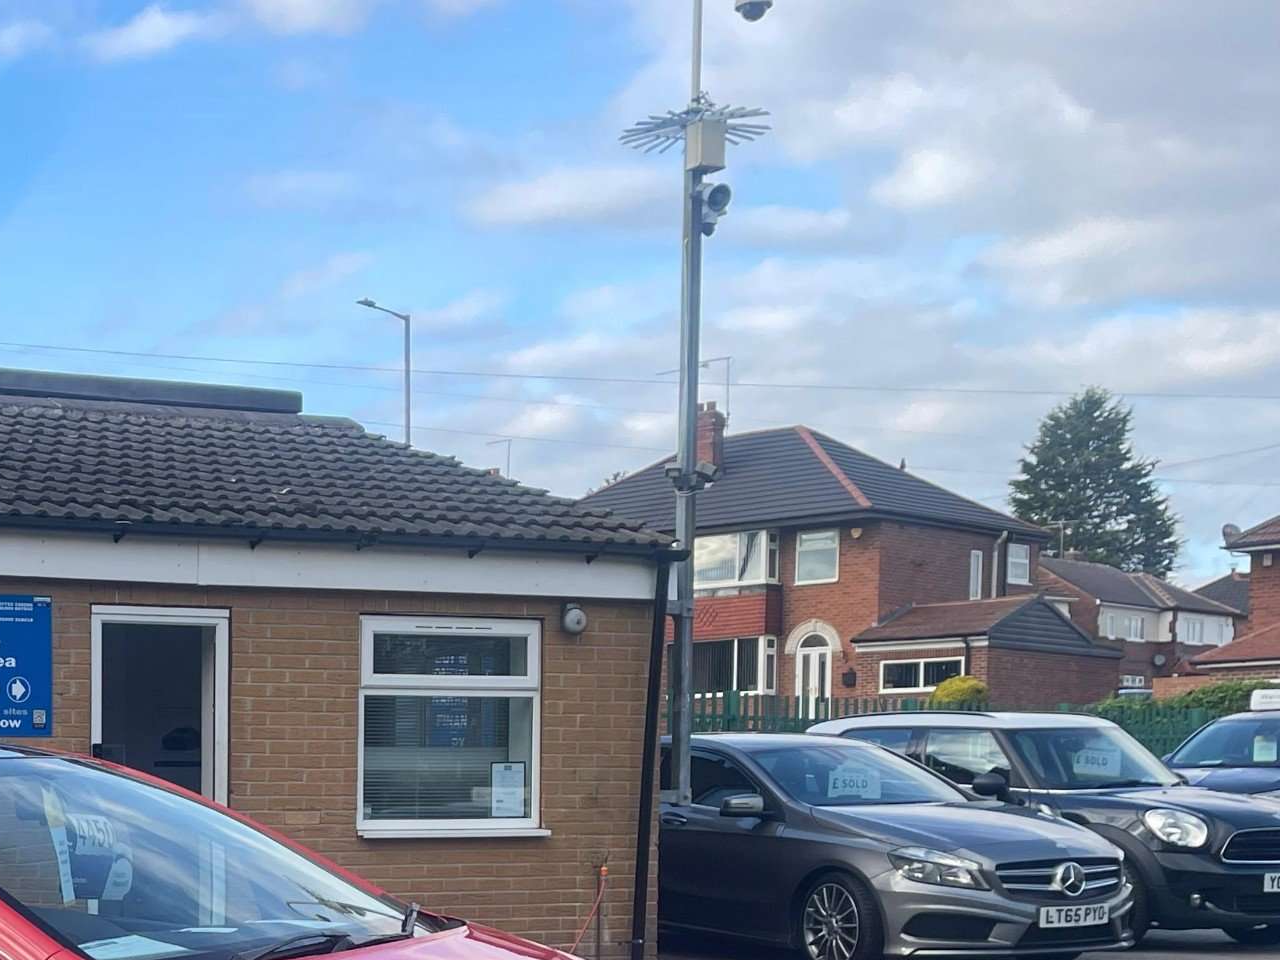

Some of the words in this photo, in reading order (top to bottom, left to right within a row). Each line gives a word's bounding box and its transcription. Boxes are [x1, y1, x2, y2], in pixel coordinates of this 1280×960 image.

[3, 707, 28, 716] sites
[841, 778, 869, 789] SOLD
[1045, 907, 1082, 925] LT65
